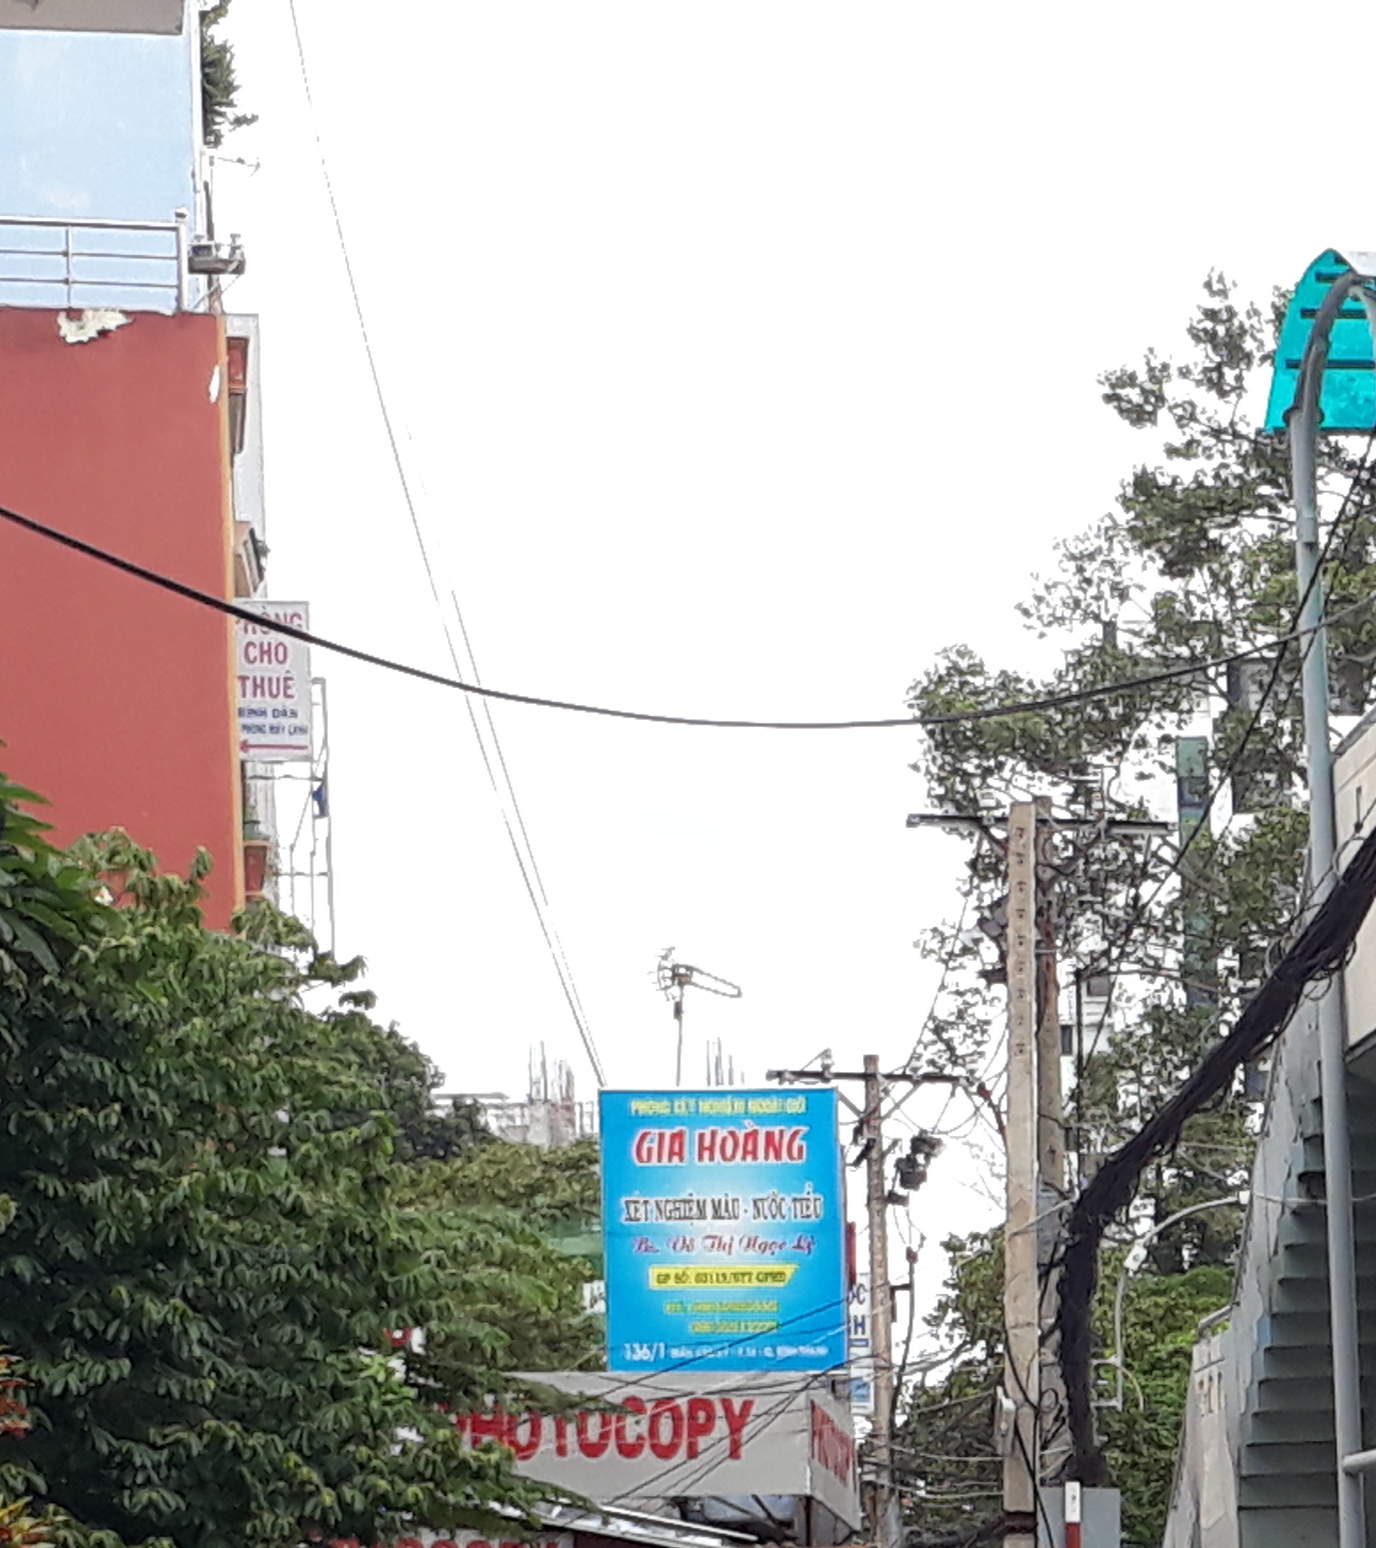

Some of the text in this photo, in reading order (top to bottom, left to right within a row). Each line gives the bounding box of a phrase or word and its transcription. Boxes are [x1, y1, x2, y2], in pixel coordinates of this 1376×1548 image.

[243, 641, 288, 665] CHO
[237, 670, 294, 699] THUÊ
[634, 1119, 809, 1165] GIA HOÀNG
[440, 1395, 756, 1462] HOTOCOPY
